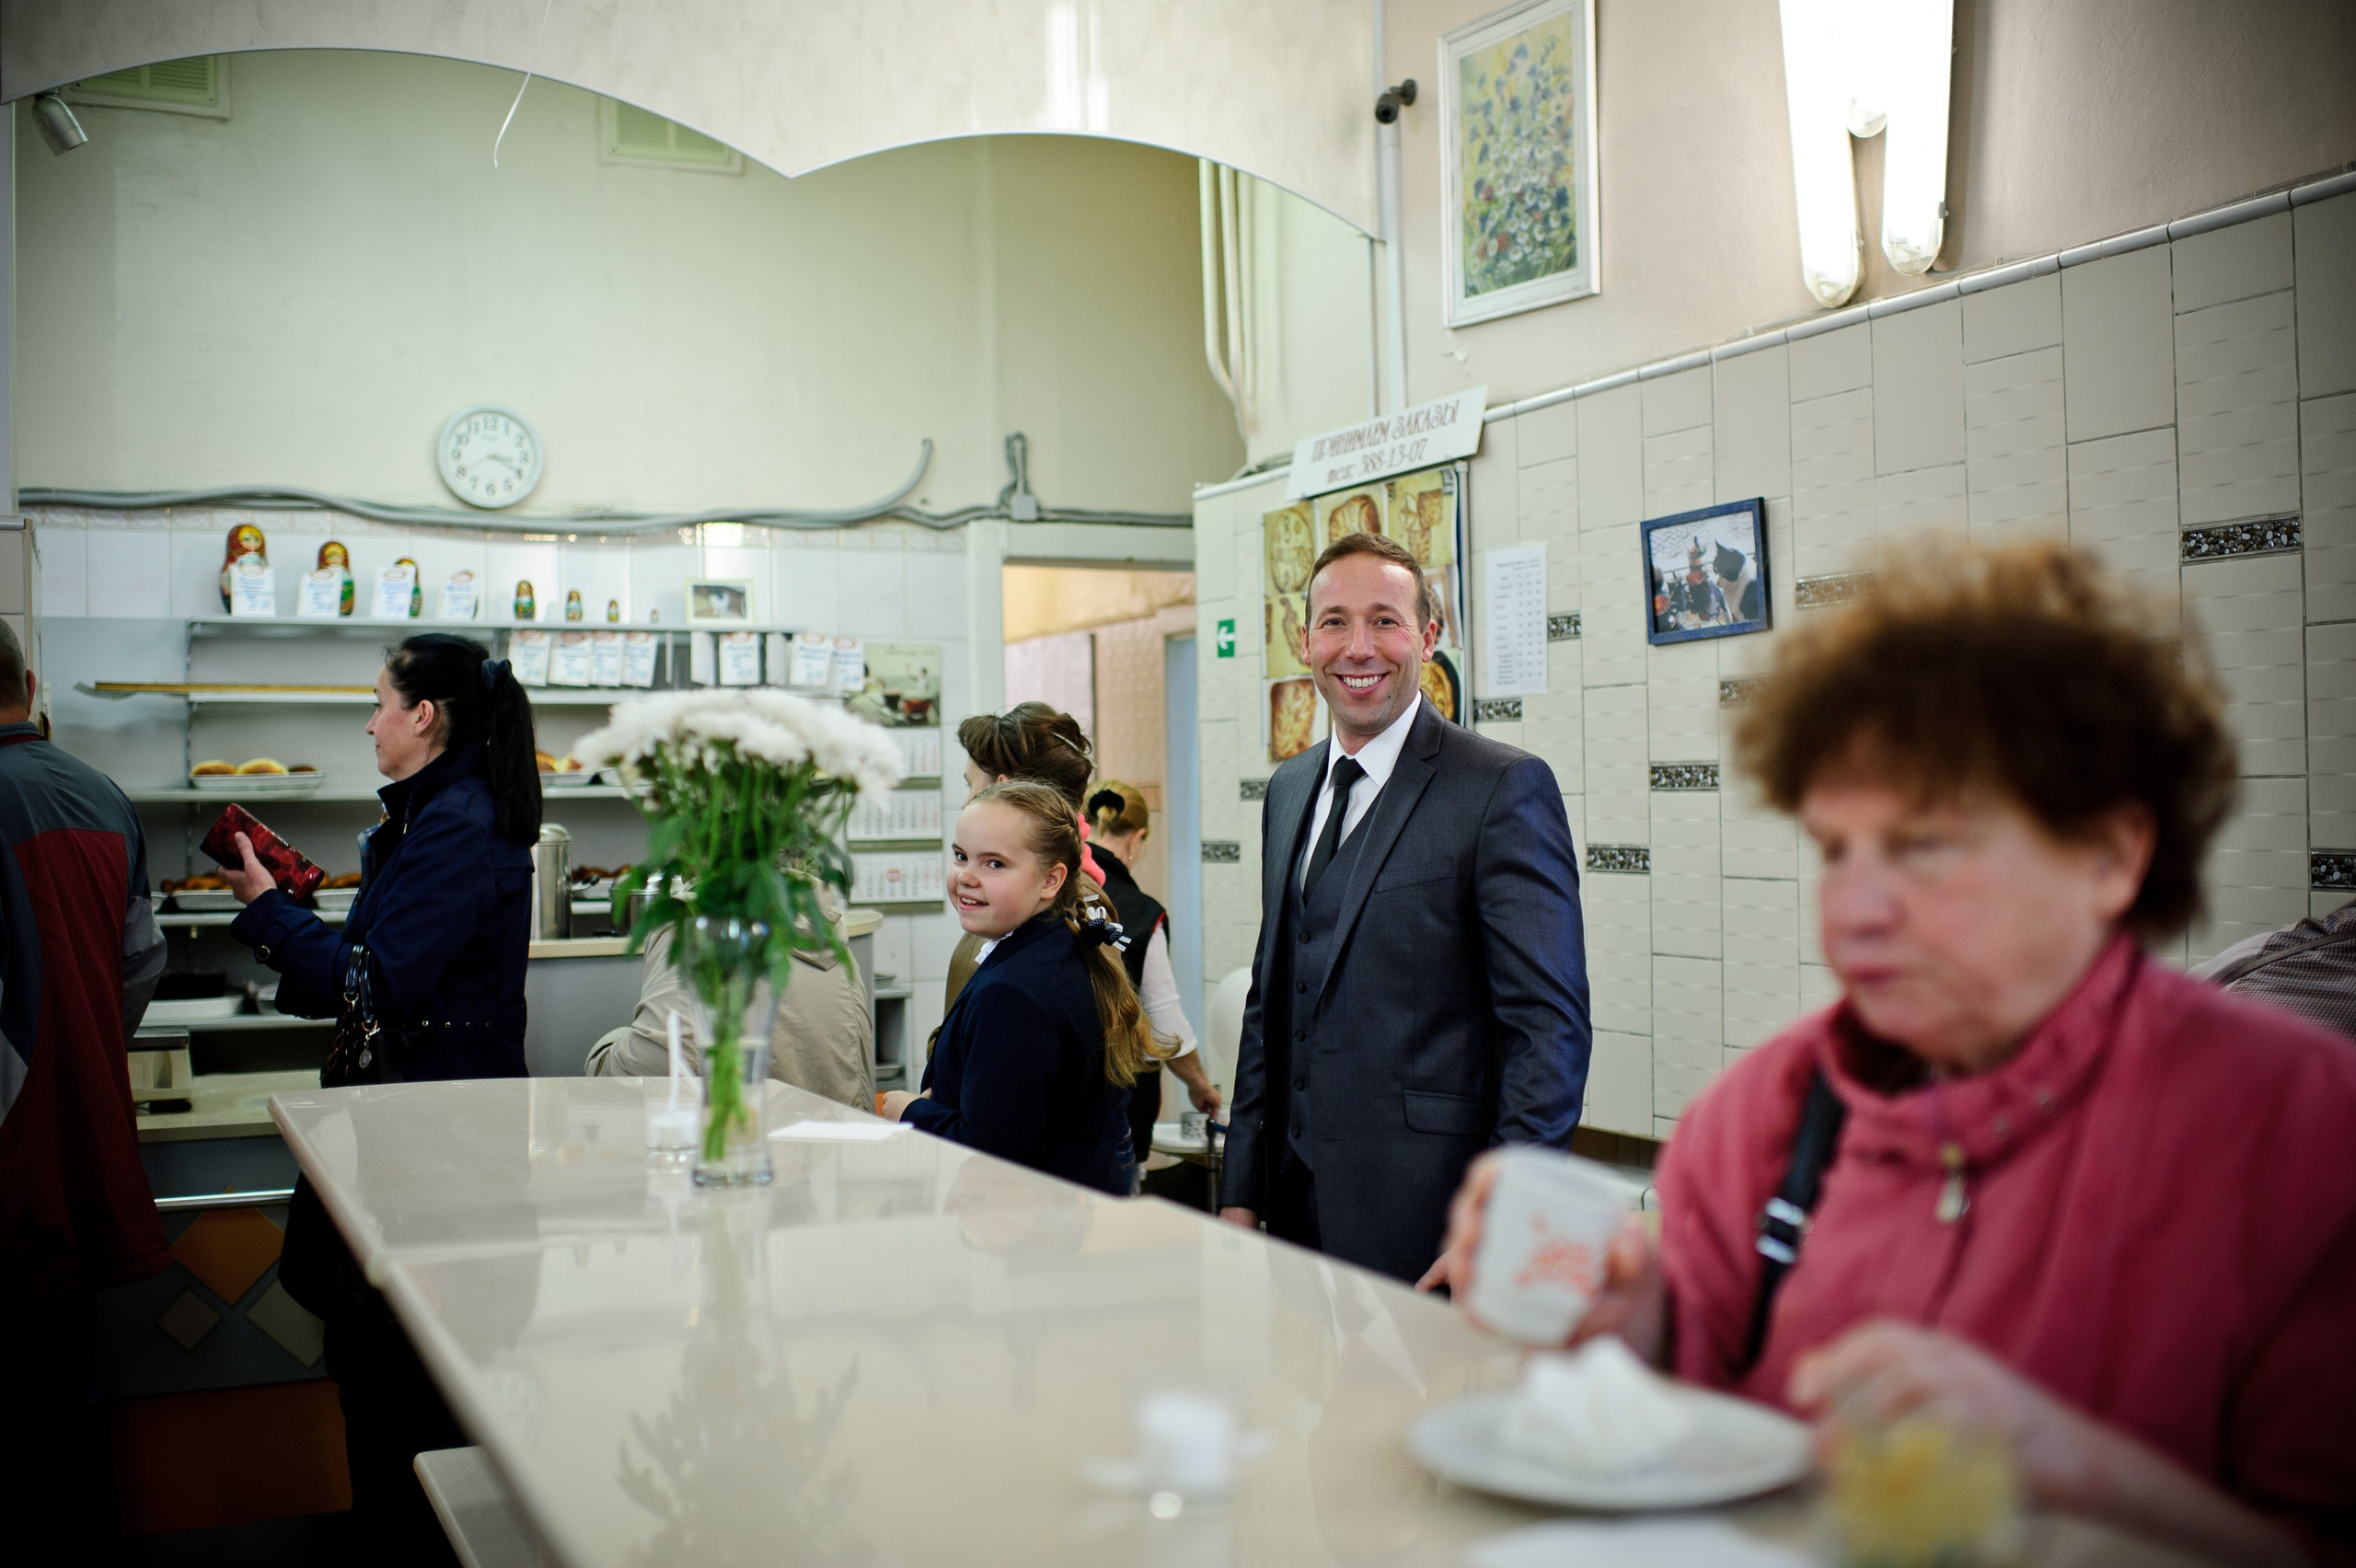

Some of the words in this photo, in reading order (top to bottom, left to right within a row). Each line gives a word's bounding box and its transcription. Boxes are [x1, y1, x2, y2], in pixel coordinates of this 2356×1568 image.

[467, 419, 479, 435] 11
[482, 415, 498, 432] 12
[1392, 399, 1461, 441] ЗАКАЗЫ
[456, 432, 470, 448] 10
[514, 432, 525, 448] 2
[1358, 437, 1429, 475] 388-13-07
[468, 475, 479, 491] 7
[485, 478, 496, 497] 6
[502, 477, 514, 493] 5
